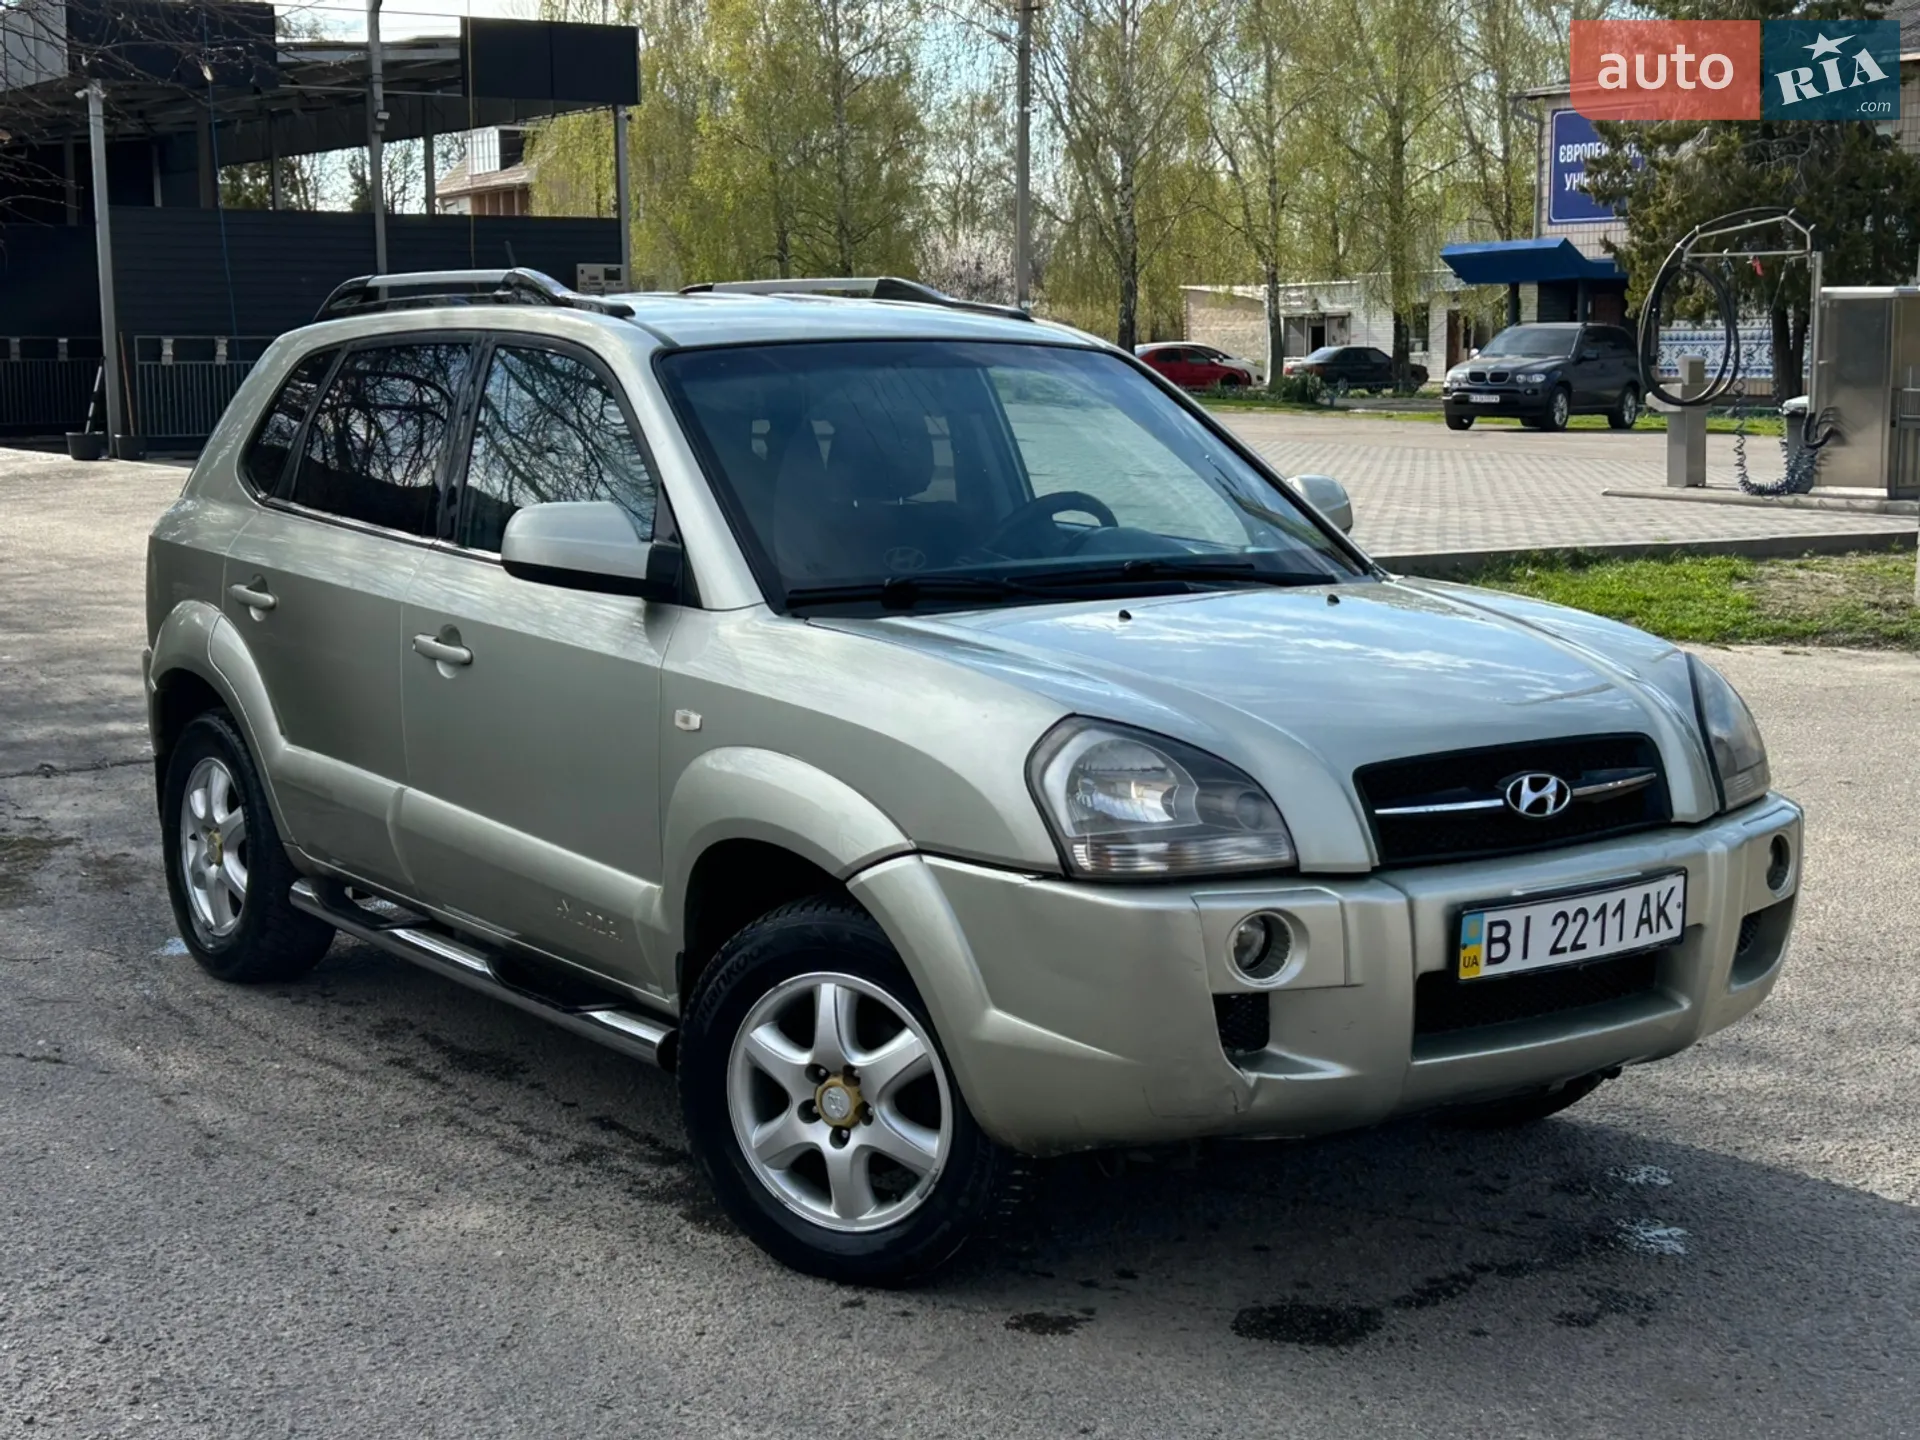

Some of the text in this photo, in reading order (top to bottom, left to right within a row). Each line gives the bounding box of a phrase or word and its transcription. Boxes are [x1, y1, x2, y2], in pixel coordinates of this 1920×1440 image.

[1485, 886, 1675, 967] BI 2211 AK
[1462, 954, 1479, 969] UA
